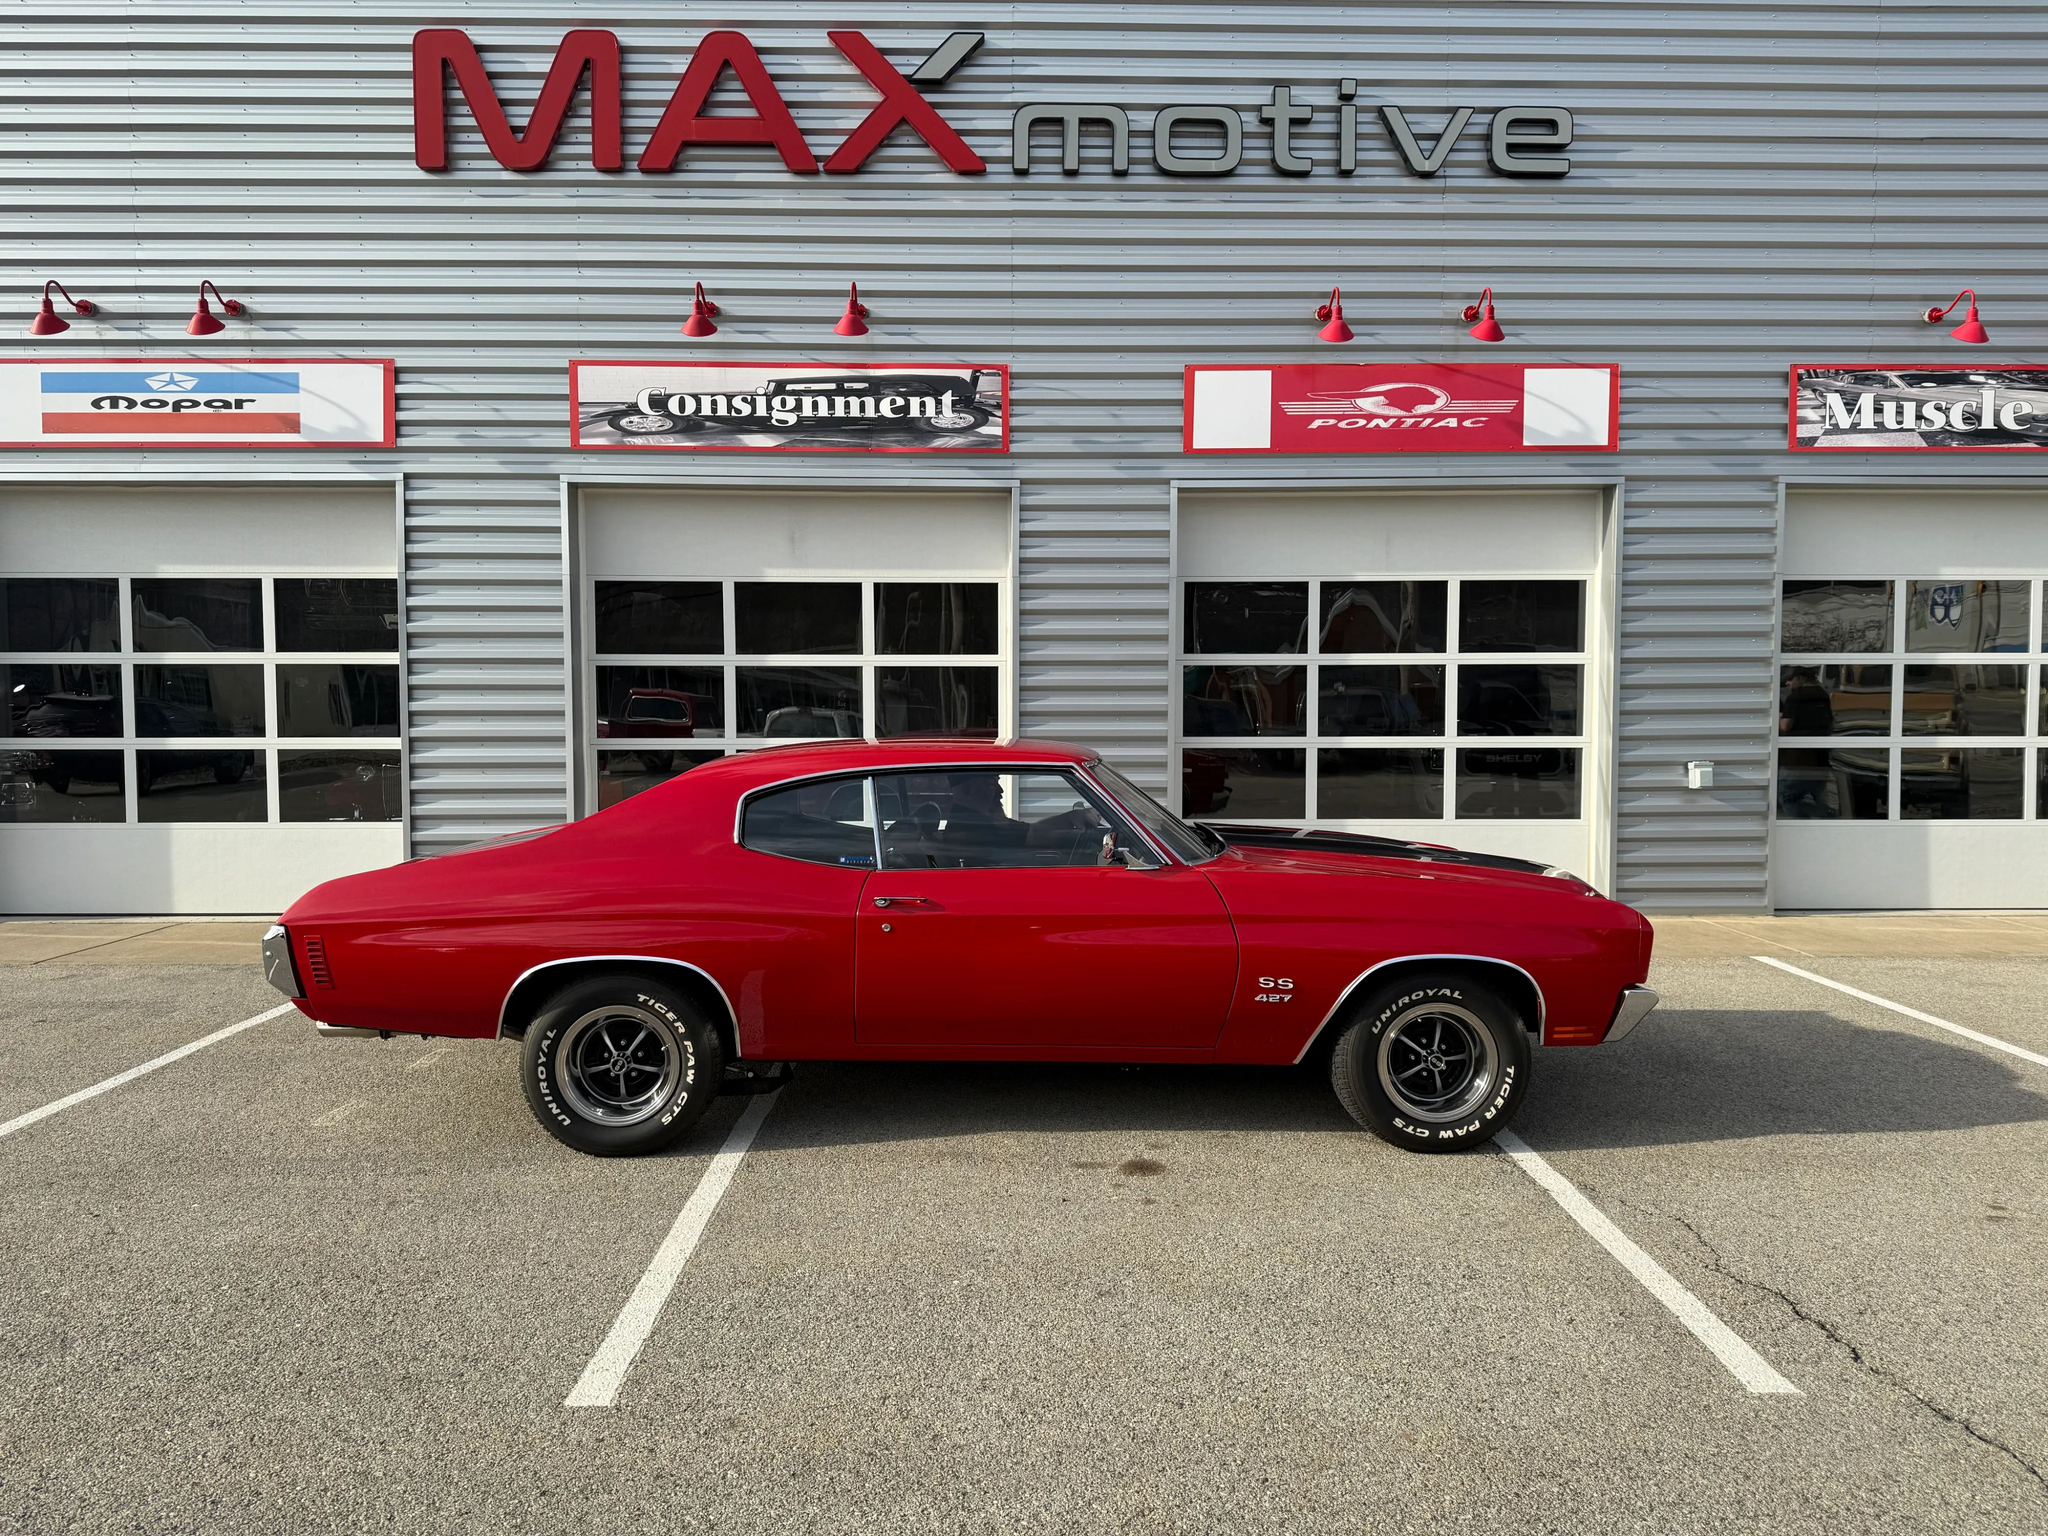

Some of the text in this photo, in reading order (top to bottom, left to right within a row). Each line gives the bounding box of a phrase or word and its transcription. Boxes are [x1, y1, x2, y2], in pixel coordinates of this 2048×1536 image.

[413, 29, 1574, 176] MAX motive
[635, 386, 961, 428] Consignment
[1307, 417, 1489, 429] PONTIAC
[1821, 389, 2034, 433] Muscle
[1486, 754, 1542, 762] SHELBY
[1254, 993, 1293, 1003] 427
[1258, 976, 1294, 990] SS
[1371, 988, 1463, 1035] UNIROYAL
[537, 1028, 572, 1127] UNIROYAL
[636, 993, 696, 1126] TIGER PAW GTS
[1392, 1065, 1515, 1139] TIGER PAW GTS
